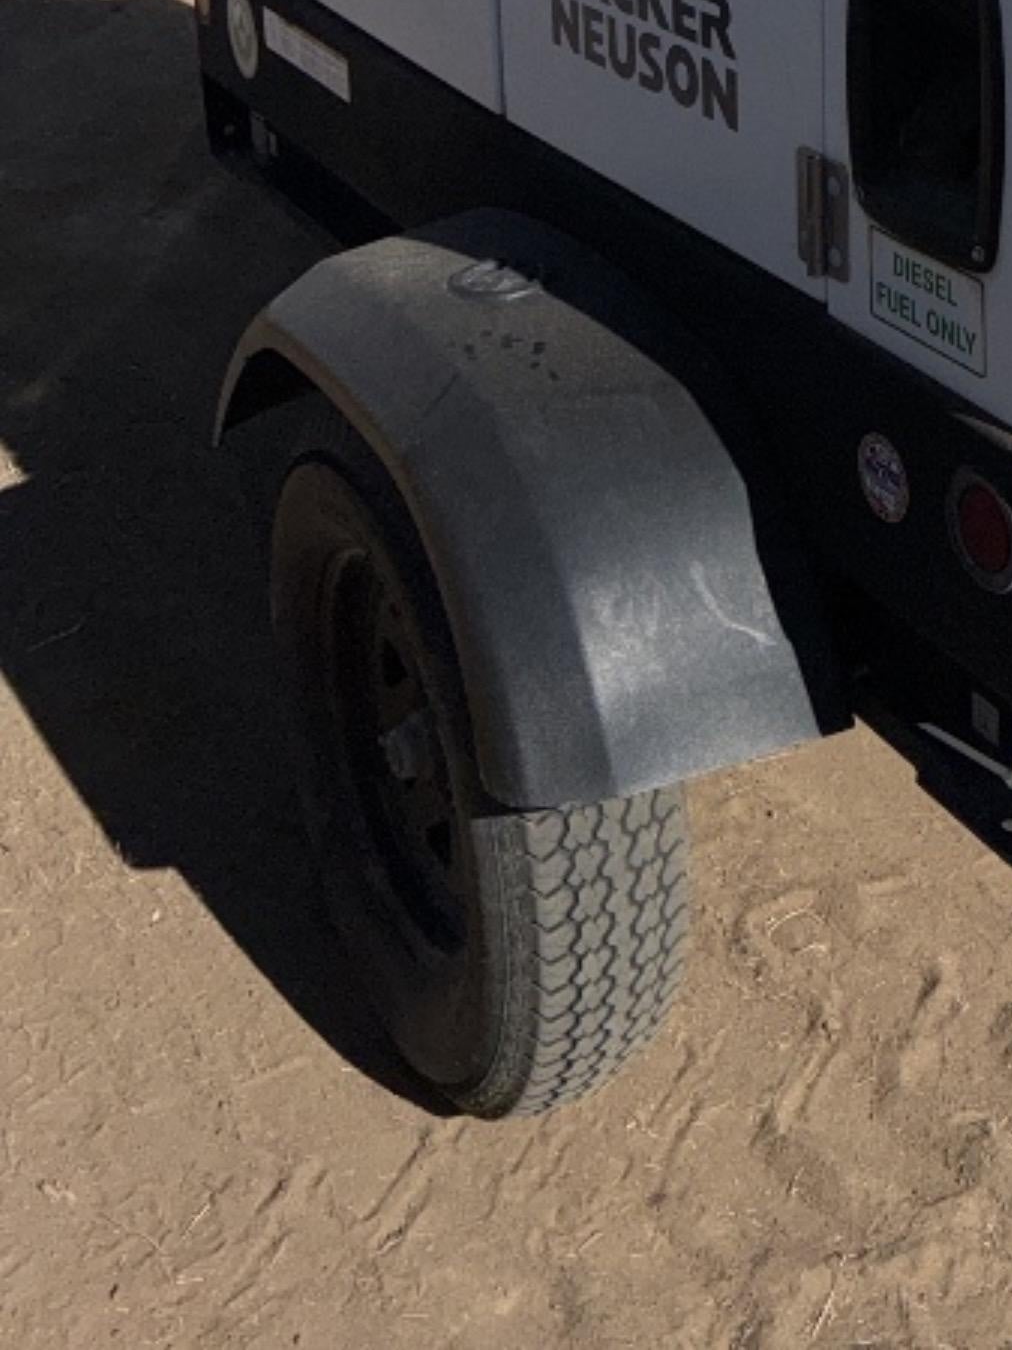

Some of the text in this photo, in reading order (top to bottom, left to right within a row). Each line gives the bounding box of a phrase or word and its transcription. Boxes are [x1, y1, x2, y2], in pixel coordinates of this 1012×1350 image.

[892, 251, 958, 308] DIESEL
[876, 280, 977, 356] FUEL ONLY
